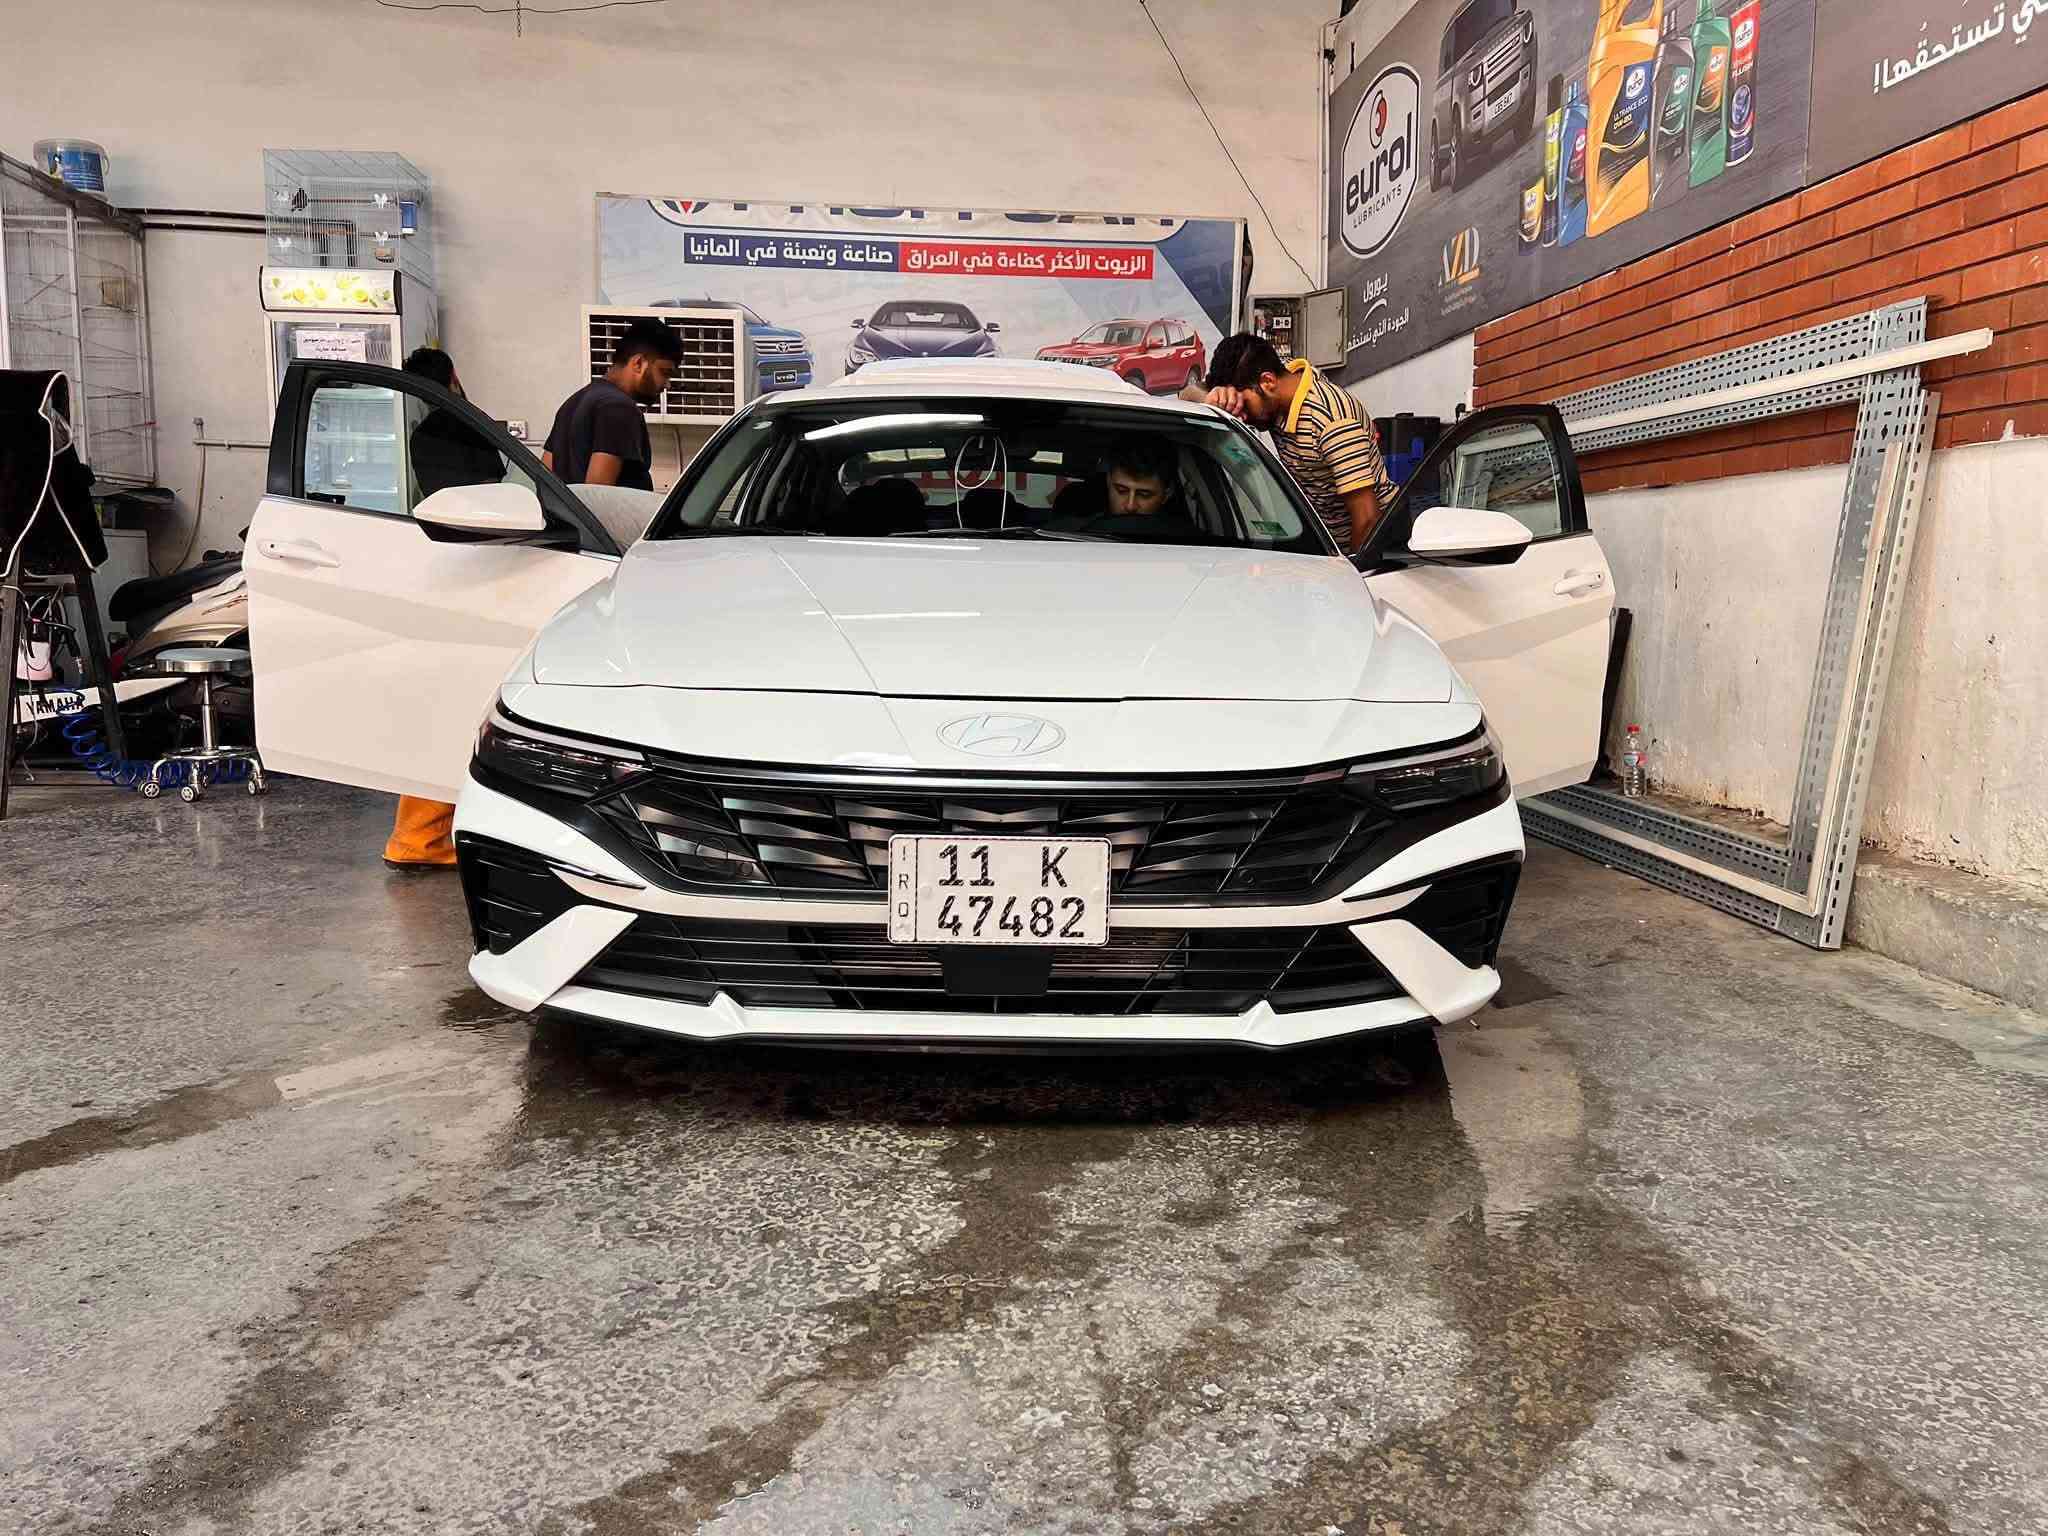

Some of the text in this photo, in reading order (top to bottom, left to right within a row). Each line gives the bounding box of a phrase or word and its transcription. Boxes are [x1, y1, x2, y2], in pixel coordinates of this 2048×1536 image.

[1346, 112, 1412, 215] eurol
[1353, 184, 1402, 229] LUBRICANTS
[690, 237, 893, 265] صناعة وتعبئة في المانيا
[907, 250, 1146, 275] الزيوت الأكثر كفاءة في العراق
[1363, 272, 1388, 303] يورول
[1372, 321, 1387, 347] التي
[1387, 307, 1409, 332] الجودة
[26, 695, 84, 714] YAMAHA
[939, 844, 1069, 887] 11 K
[937, 895, 1085, 938] 47482
